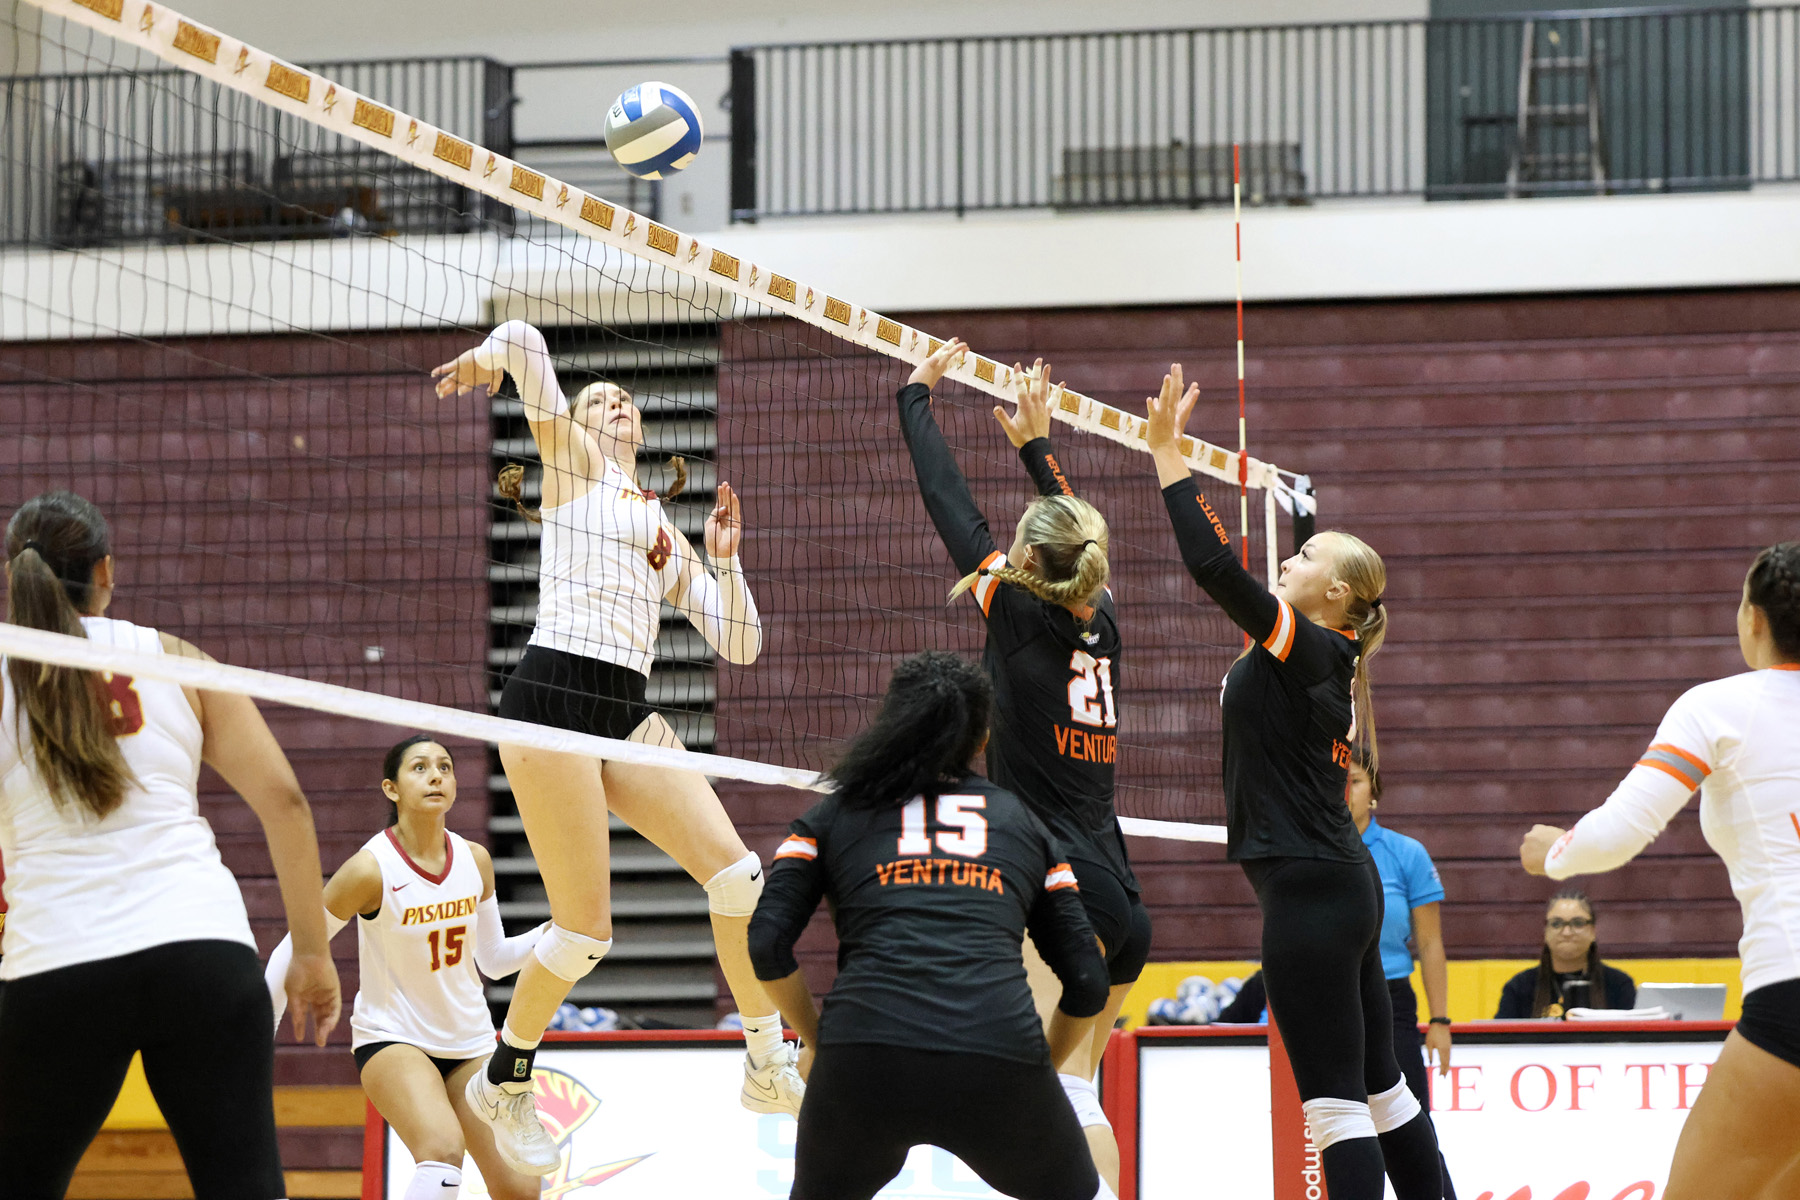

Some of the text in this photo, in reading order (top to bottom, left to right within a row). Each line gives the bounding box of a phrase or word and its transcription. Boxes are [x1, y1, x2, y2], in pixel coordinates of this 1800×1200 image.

[1067, 649, 1117, 728] 21
[1054, 724, 1117, 764] VENTUR
[897, 794, 988, 859] 15
[875, 858, 1004, 895] VENTURA
[401, 895, 477, 926] PASADEN
[427, 924, 467, 973] 15
[1510, 1063, 1602, 1112] OF
[1625, 1063, 1715, 1110] TH
